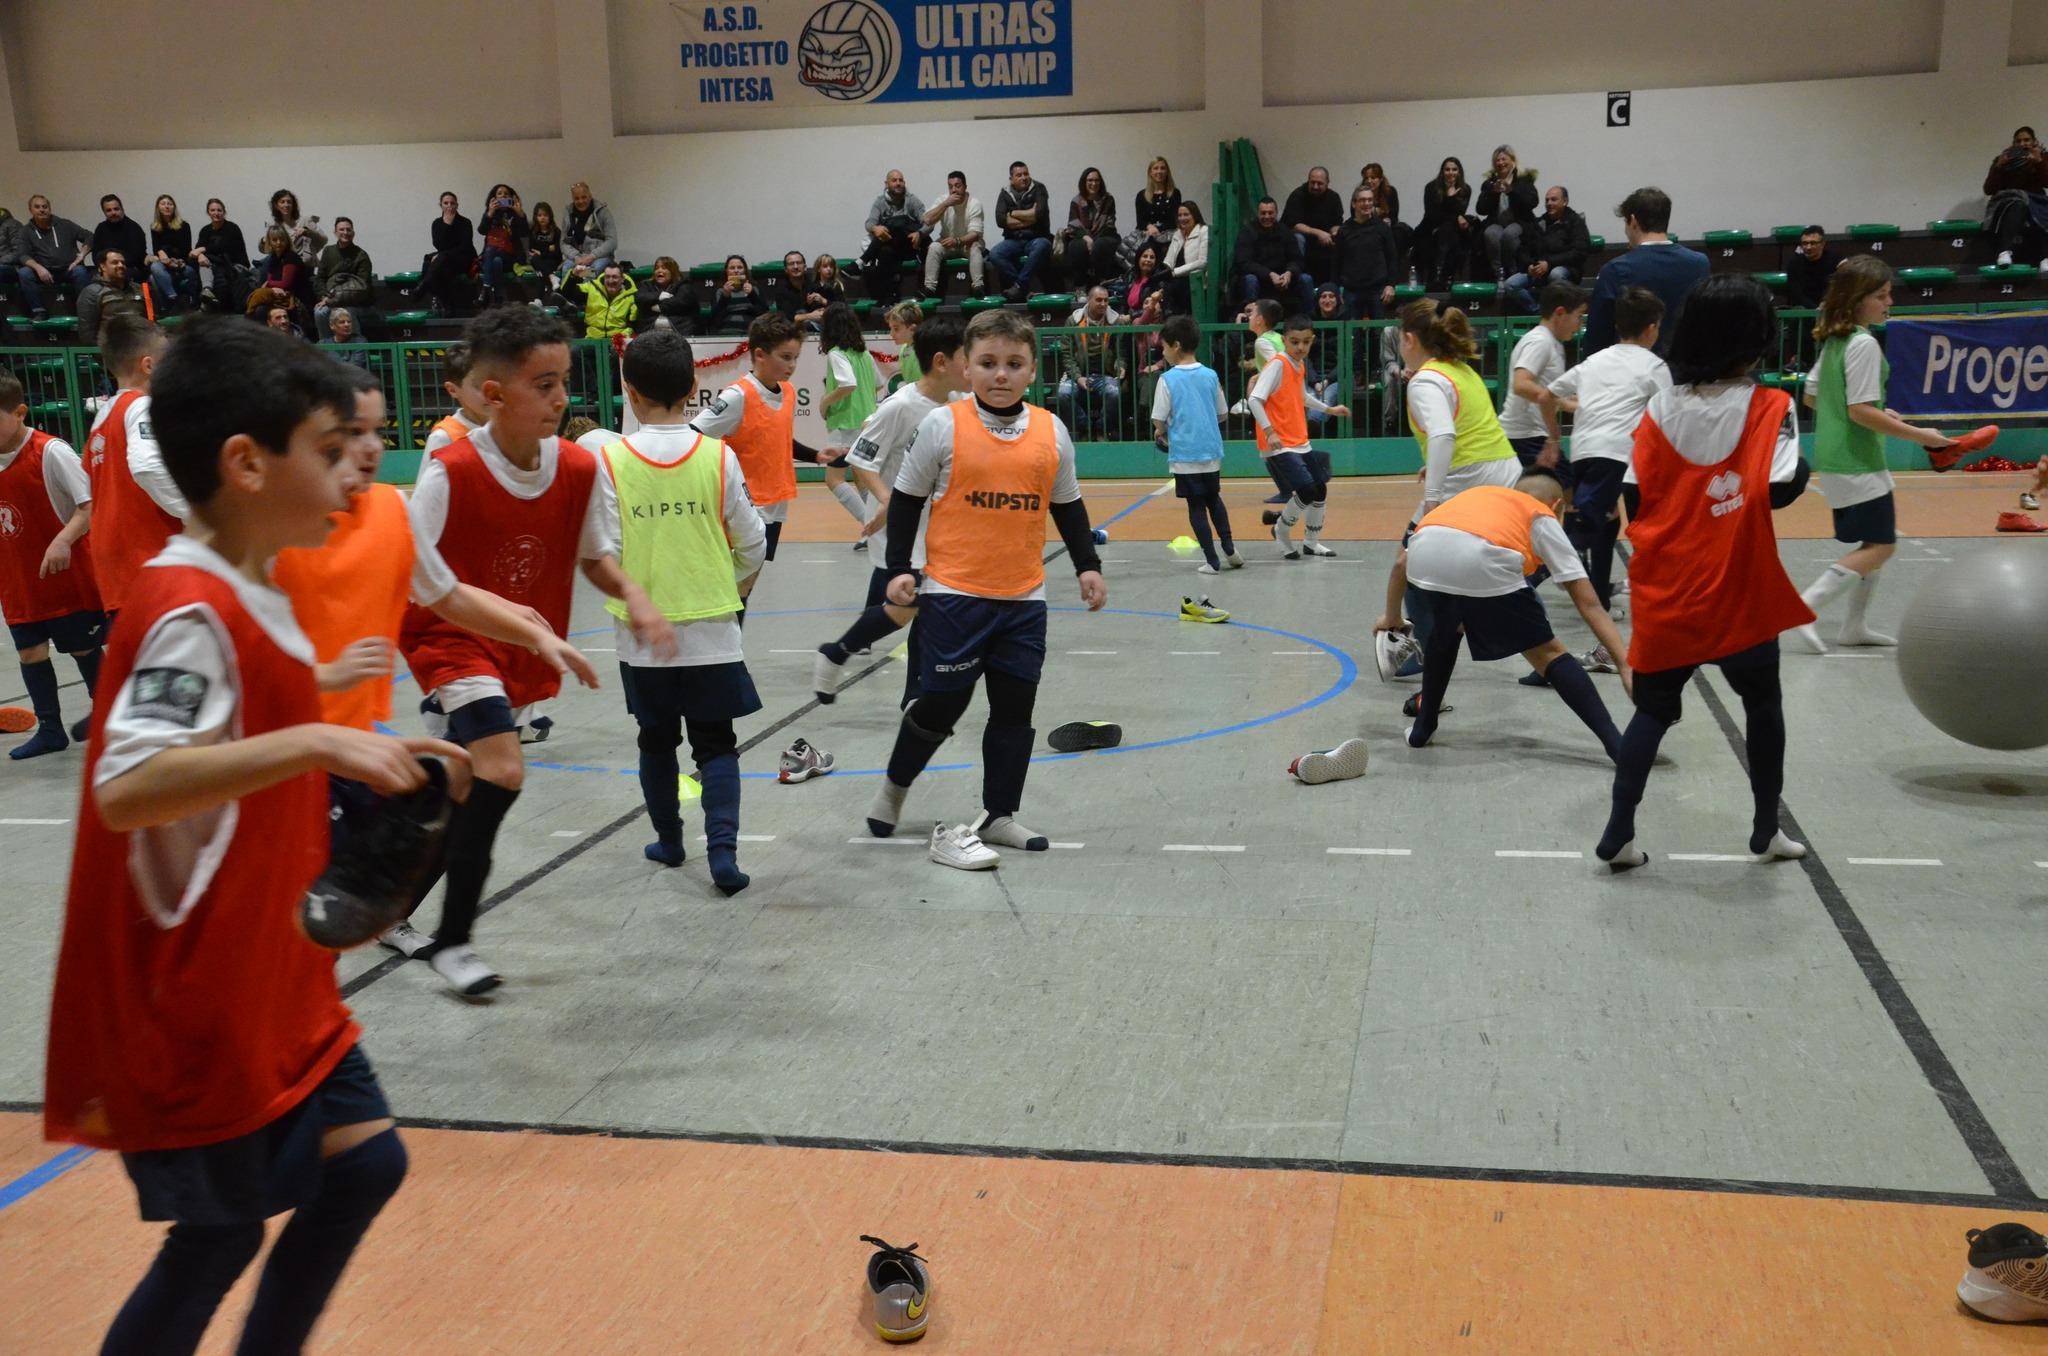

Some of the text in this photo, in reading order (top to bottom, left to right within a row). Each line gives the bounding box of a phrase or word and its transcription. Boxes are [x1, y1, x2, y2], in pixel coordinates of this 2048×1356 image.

[703, 7, 763, 32] A.S.D.
[915, 0, 1057, 50] ULTRAS
[680, 40, 789, 68] PROGETTO
[916, 51, 1057, 90] ALL CAMP
[700, 77, 774, 104] INTESA
[1610, 99, 1628, 125] C
[1722, 247, 1735, 257] 39
[1871, 241, 1884, 252] 41
[1950, 238, 1965, 249] 42
[703, 278, 715, 288] 36
[765, 277, 778, 287] 37
[955, 271, 968, 281] 40
[1040, 313, 1052, 324] 30
[1922, 334, 2048, 409] Proge
[632, 501, 707, 519] KIPSTA
